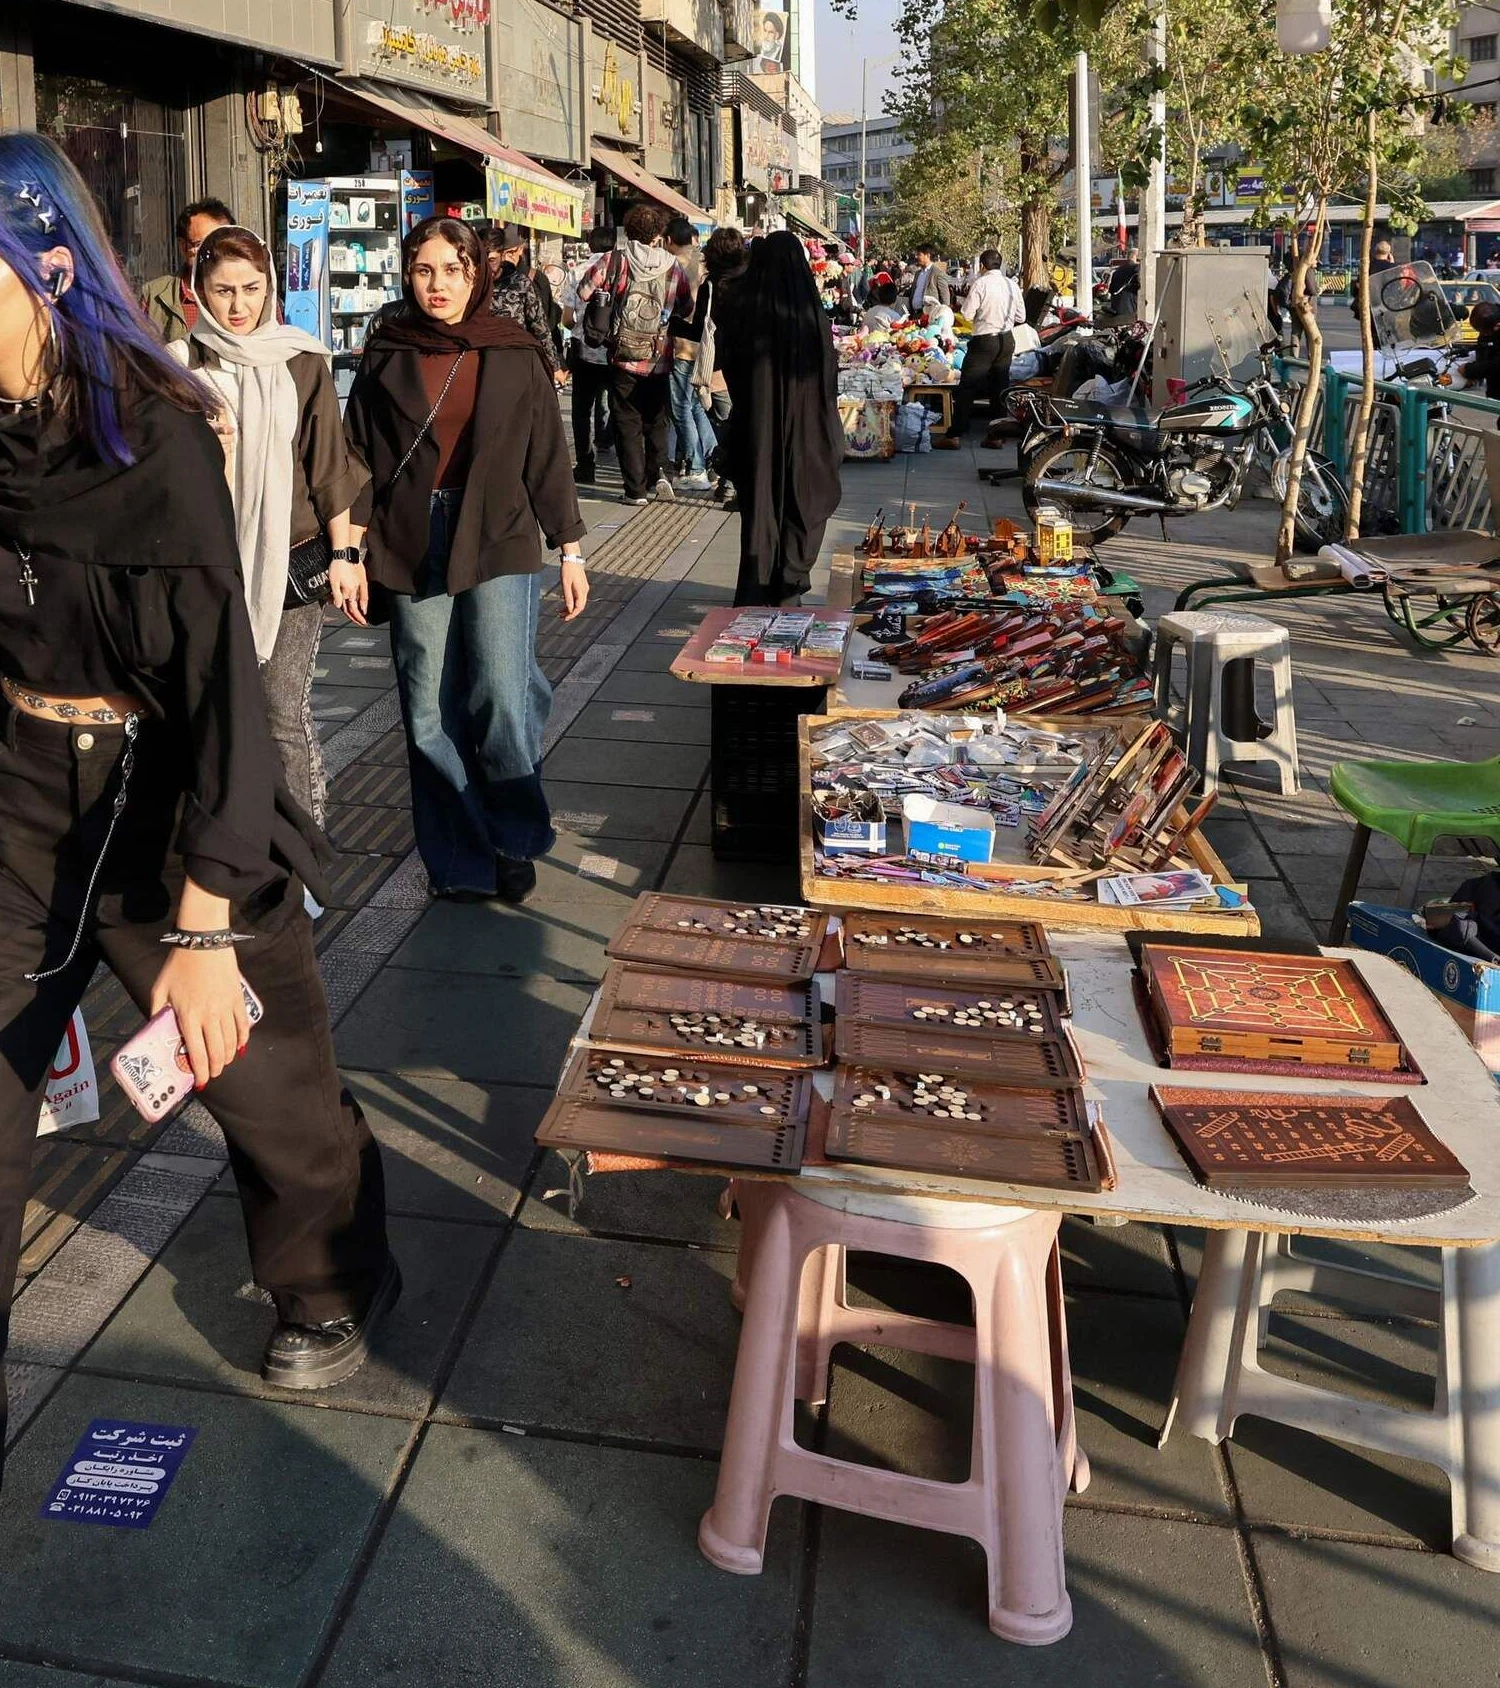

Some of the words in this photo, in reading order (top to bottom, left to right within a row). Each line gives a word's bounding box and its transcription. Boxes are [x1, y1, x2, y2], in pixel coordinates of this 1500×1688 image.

[288, 184, 328, 206] تعمیرات
[404, 193, 430, 205] فوری
[288, 211, 324, 230] فوری
[91, 1428, 148, 1446] شرکت
[150, 1433, 186, 1450] ثبت
[92, 1450, 125, 1463] رتبه
[128, 1451, 164, 1463] اخذ
[84, 1463, 118, 1474] رایگان
[70, 1476, 94, 1485] کار
[113, 1481, 153, 1493] پرداخت
